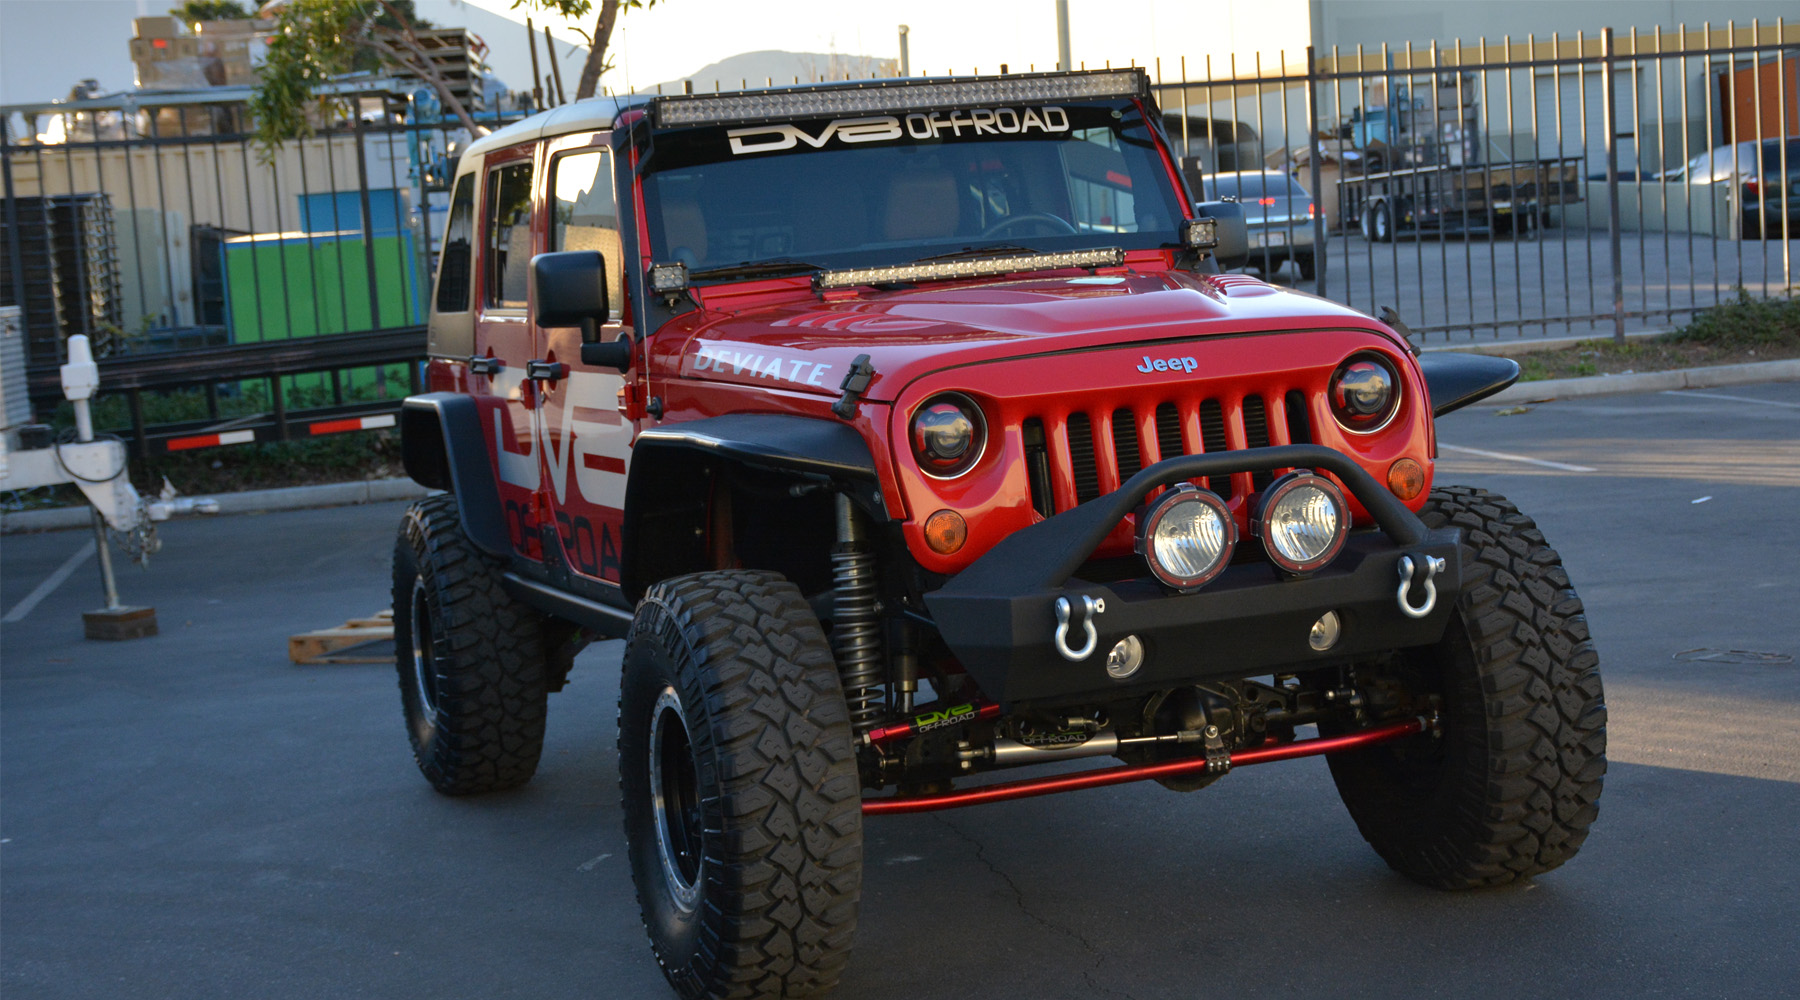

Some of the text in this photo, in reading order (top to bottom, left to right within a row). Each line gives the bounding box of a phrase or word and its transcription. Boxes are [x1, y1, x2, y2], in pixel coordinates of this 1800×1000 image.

[727, 106, 1070, 155] DV8 OFFROAD
[693, 347, 832, 386] DEVIATE
[1137, 356, 1198, 374] Jeep
[915, 703, 974, 727] DV8
